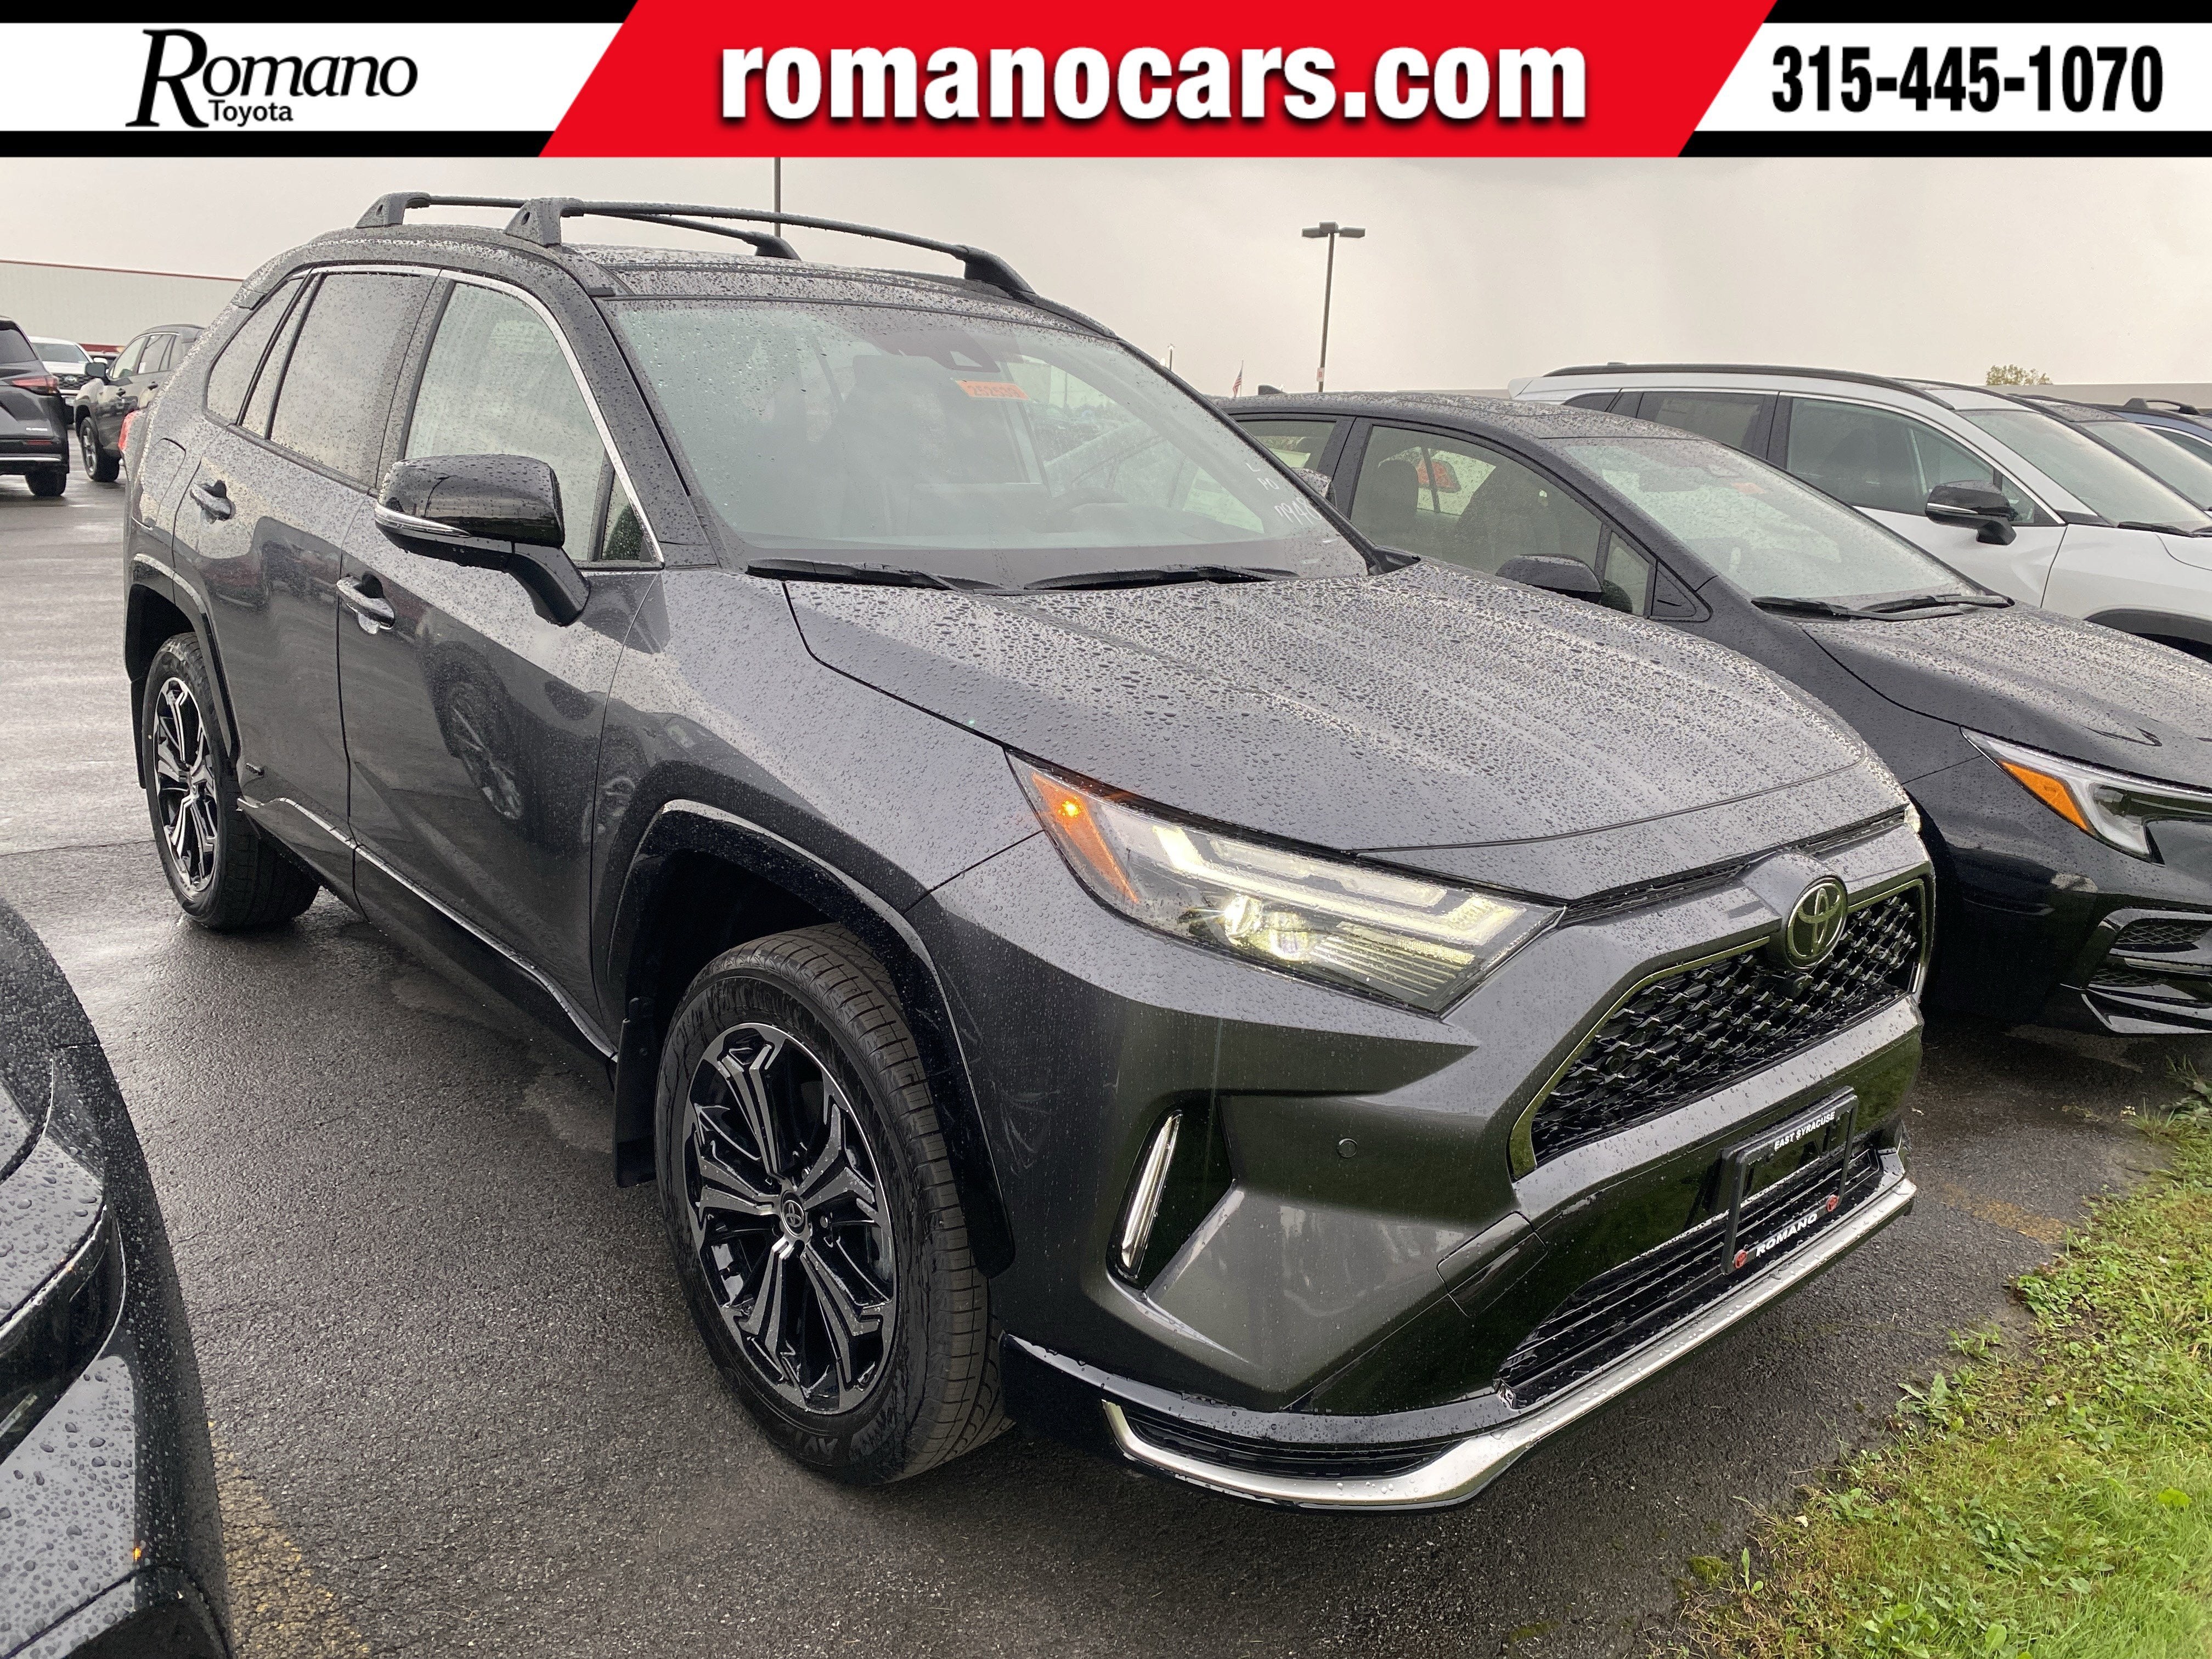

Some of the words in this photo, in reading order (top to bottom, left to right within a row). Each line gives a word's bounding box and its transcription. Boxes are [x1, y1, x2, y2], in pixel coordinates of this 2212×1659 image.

[1774, 1132, 1795, 1152] EAST
[1796, 1111, 1836, 1141] SYRACUSE
[1756, 1213, 1818, 1257] ROMANO
